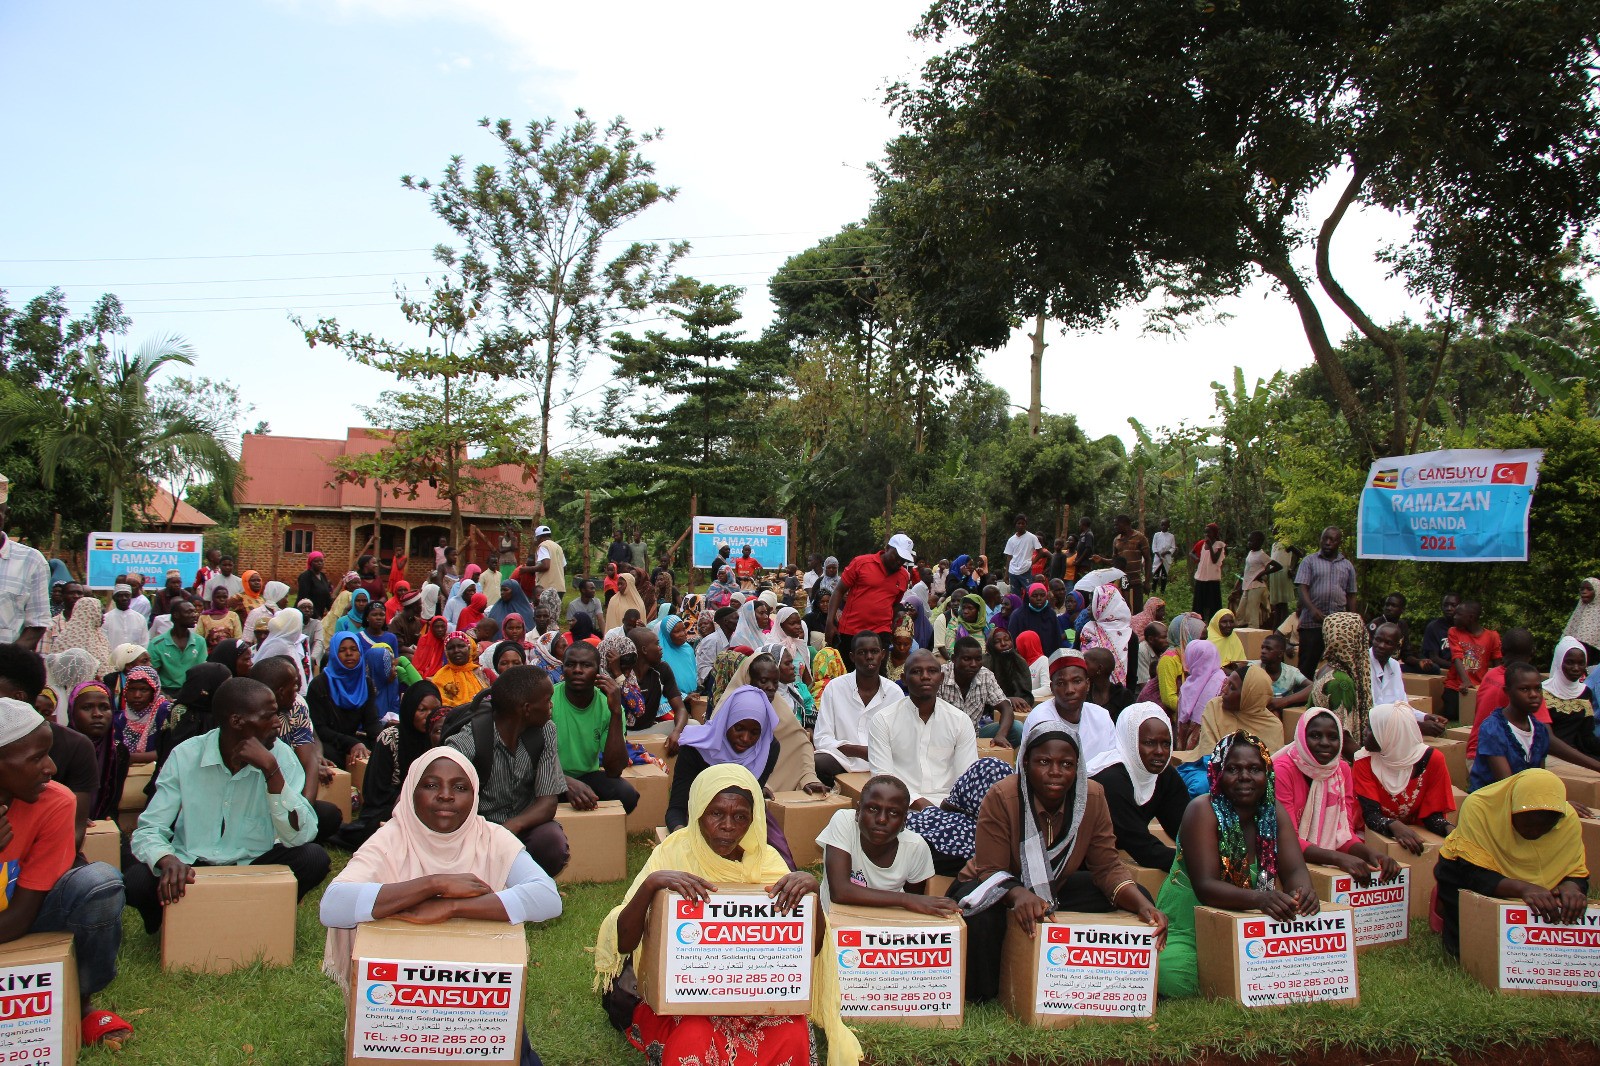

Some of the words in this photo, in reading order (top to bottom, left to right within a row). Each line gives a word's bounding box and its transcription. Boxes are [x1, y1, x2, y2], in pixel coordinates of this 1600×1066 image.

[1419, 467, 1488, 480] CANSUYU
[1392, 491, 1490, 512] RAMAZAN
[1411, 517, 1466, 530] UGANDA
[1421, 536, 1456, 550] 2021
[112, 554, 178, 564] RAMAZAN
[1351, 889, 1403, 905] CANSUYU
[704, 926, 802, 942] CANSUYU
[866, 932, 951, 945] TÜRKİYE
[1074, 929, 1151, 945] TÜRKİYE
[1267, 936, 1344, 954] CANSUYU
[862, 950, 950, 965] CANSUYU
[1070, 950, 1149, 965] CANSUYU
[404, 966, 512, 983] TÜRKİYE
[675, 975, 696, 983] TEL:
[700, 975, 723, 983] +90
[726, 975, 742, 983] 312
[746, 974, 767, 983] 285
[771, 974, 784, 982] 20
[788, 974, 802, 982] 03
[1507, 978, 1600, 988] www.cansuyu.org.
[398, 988, 508, 1005] CANSUYU
[675, 985, 800, 996] www.cansuyu.org.tr
[1248, 986, 1348, 1000] www.cansuyu.org.tr
[1044, 1002, 1145, 1013] www.cansuyu.org.tr
[1, 1027, 50, 1037] rganization
[364, 1032, 388, 1041] TEL:
[392, 1033, 417, 1042] +90
[421, 1035, 439, 1043] 312
[443, 1035, 466, 1043] 285
[10, 1050, 28, 1061] 20
[33, 1047, 50, 1057] 03
[364, 1045, 504, 1056] www.cansuyu.org.tr
